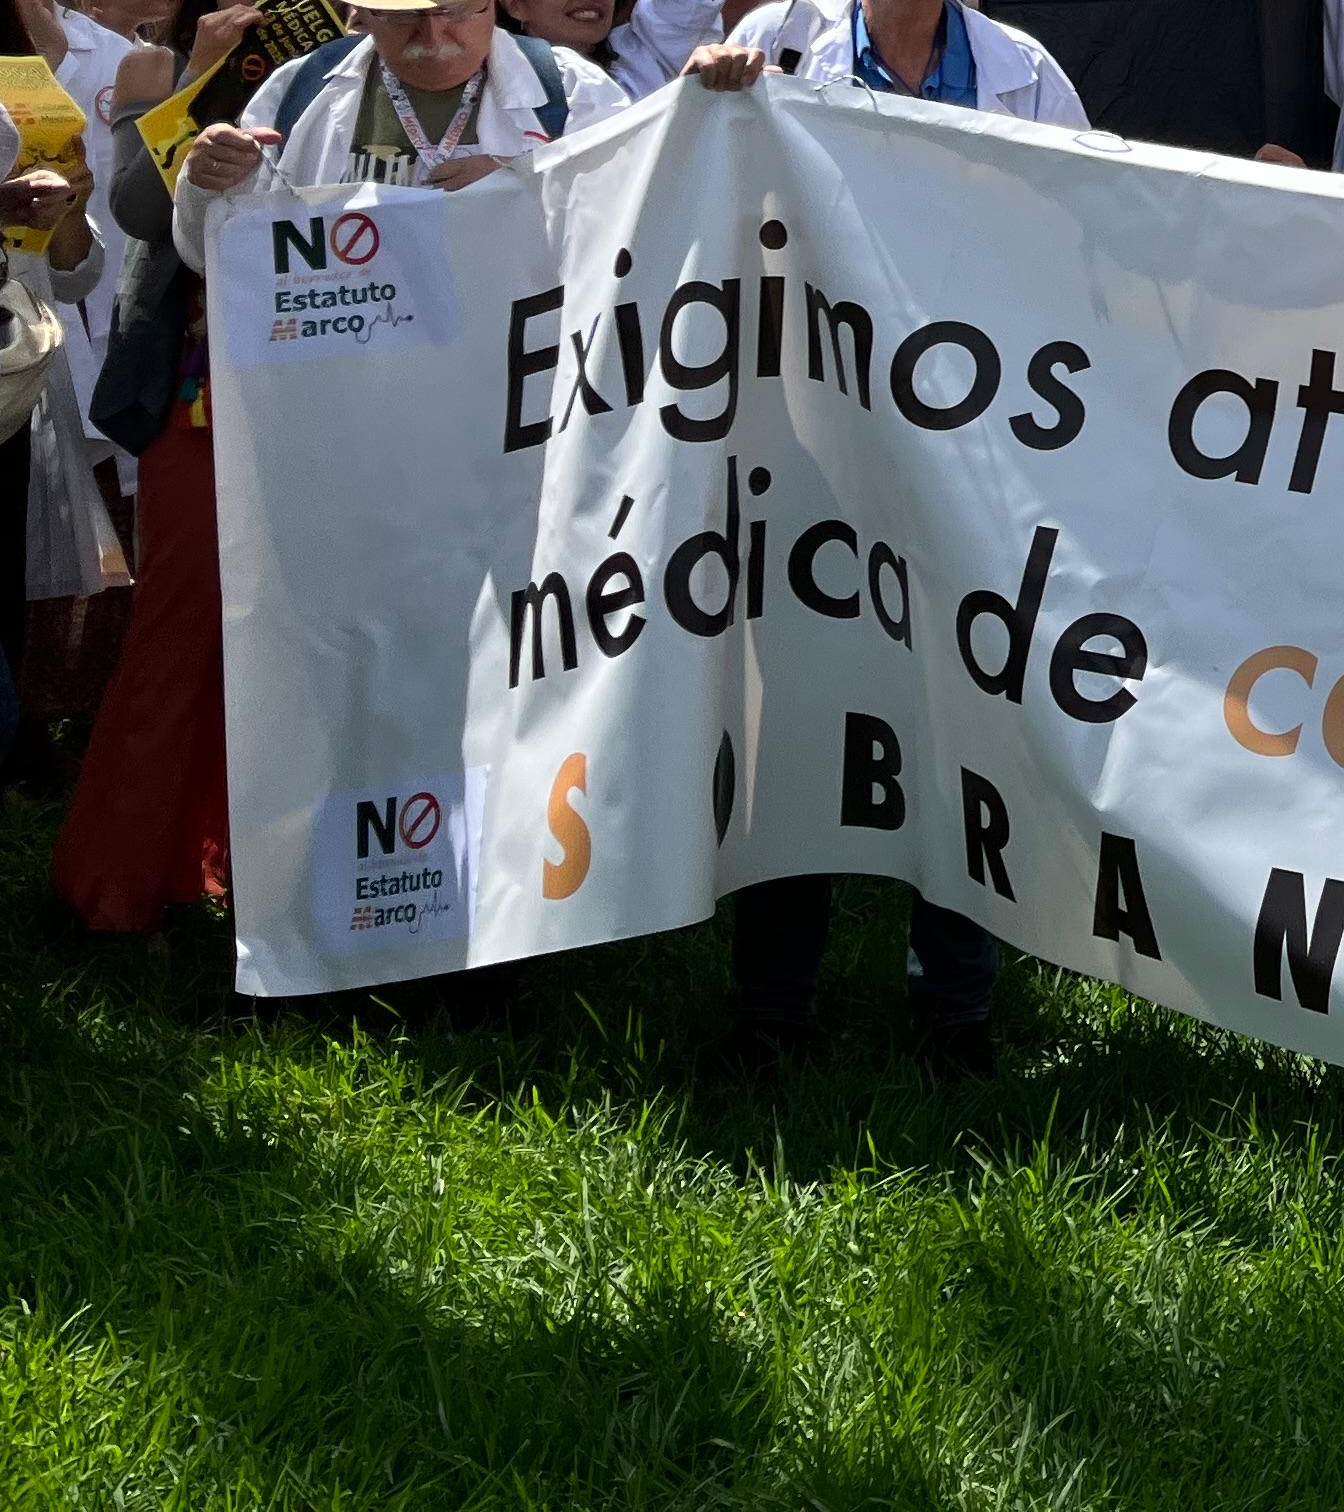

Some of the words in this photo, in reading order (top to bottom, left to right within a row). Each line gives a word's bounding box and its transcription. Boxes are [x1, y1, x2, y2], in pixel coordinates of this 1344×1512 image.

[275, 281, 397, 314] Estatuto
[503, 218, 1093, 455] Exigimos
[507, 455, 914, 690] médica
[955, 525, 1149, 725] de
[356, 867, 443, 901] Estatuto
